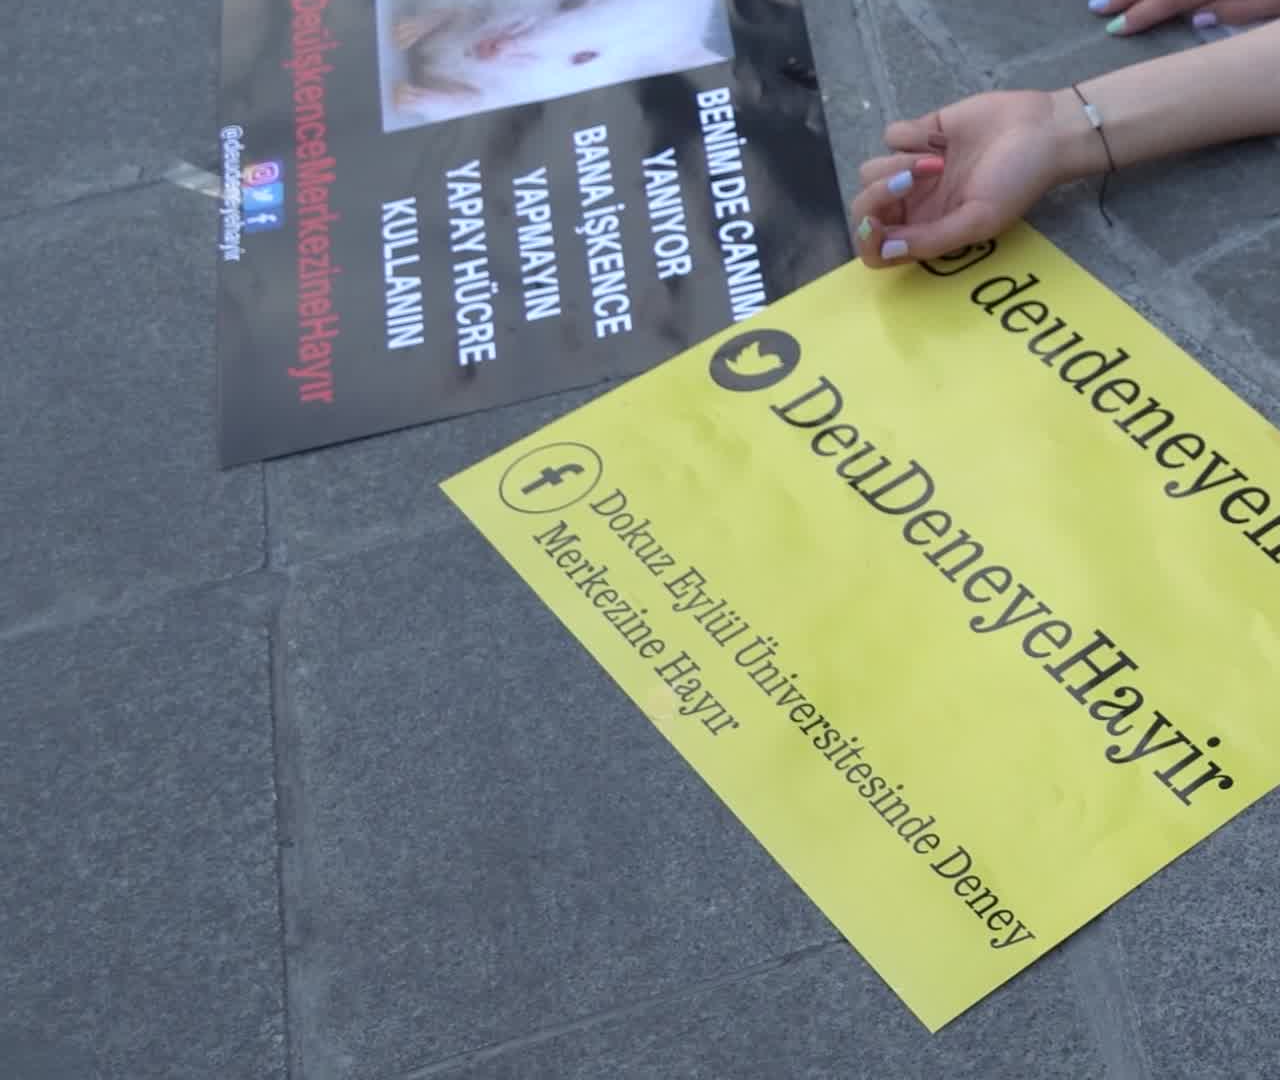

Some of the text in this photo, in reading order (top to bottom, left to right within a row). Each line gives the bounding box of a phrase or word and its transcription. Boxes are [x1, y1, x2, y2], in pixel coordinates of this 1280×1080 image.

[382, 196, 425, 349] KULLANIN
[445, 159, 499, 366] YAPAY HÜCRE
[512, 167, 561, 321] YAPMAYIN
[573, 124, 632, 338] BANA İŞKENCE
[641, 147, 692, 280] YANIYOR
[696, 87, 767, 322] BENİM DE CANIM
[532, 520, 740, 736] Merkezine Hayır
[770, 375, 1235, 806] DeuDeneyeHayir
[590, 488, 1036, 950] Dokuz Eylül Üniversitesinde Deney
